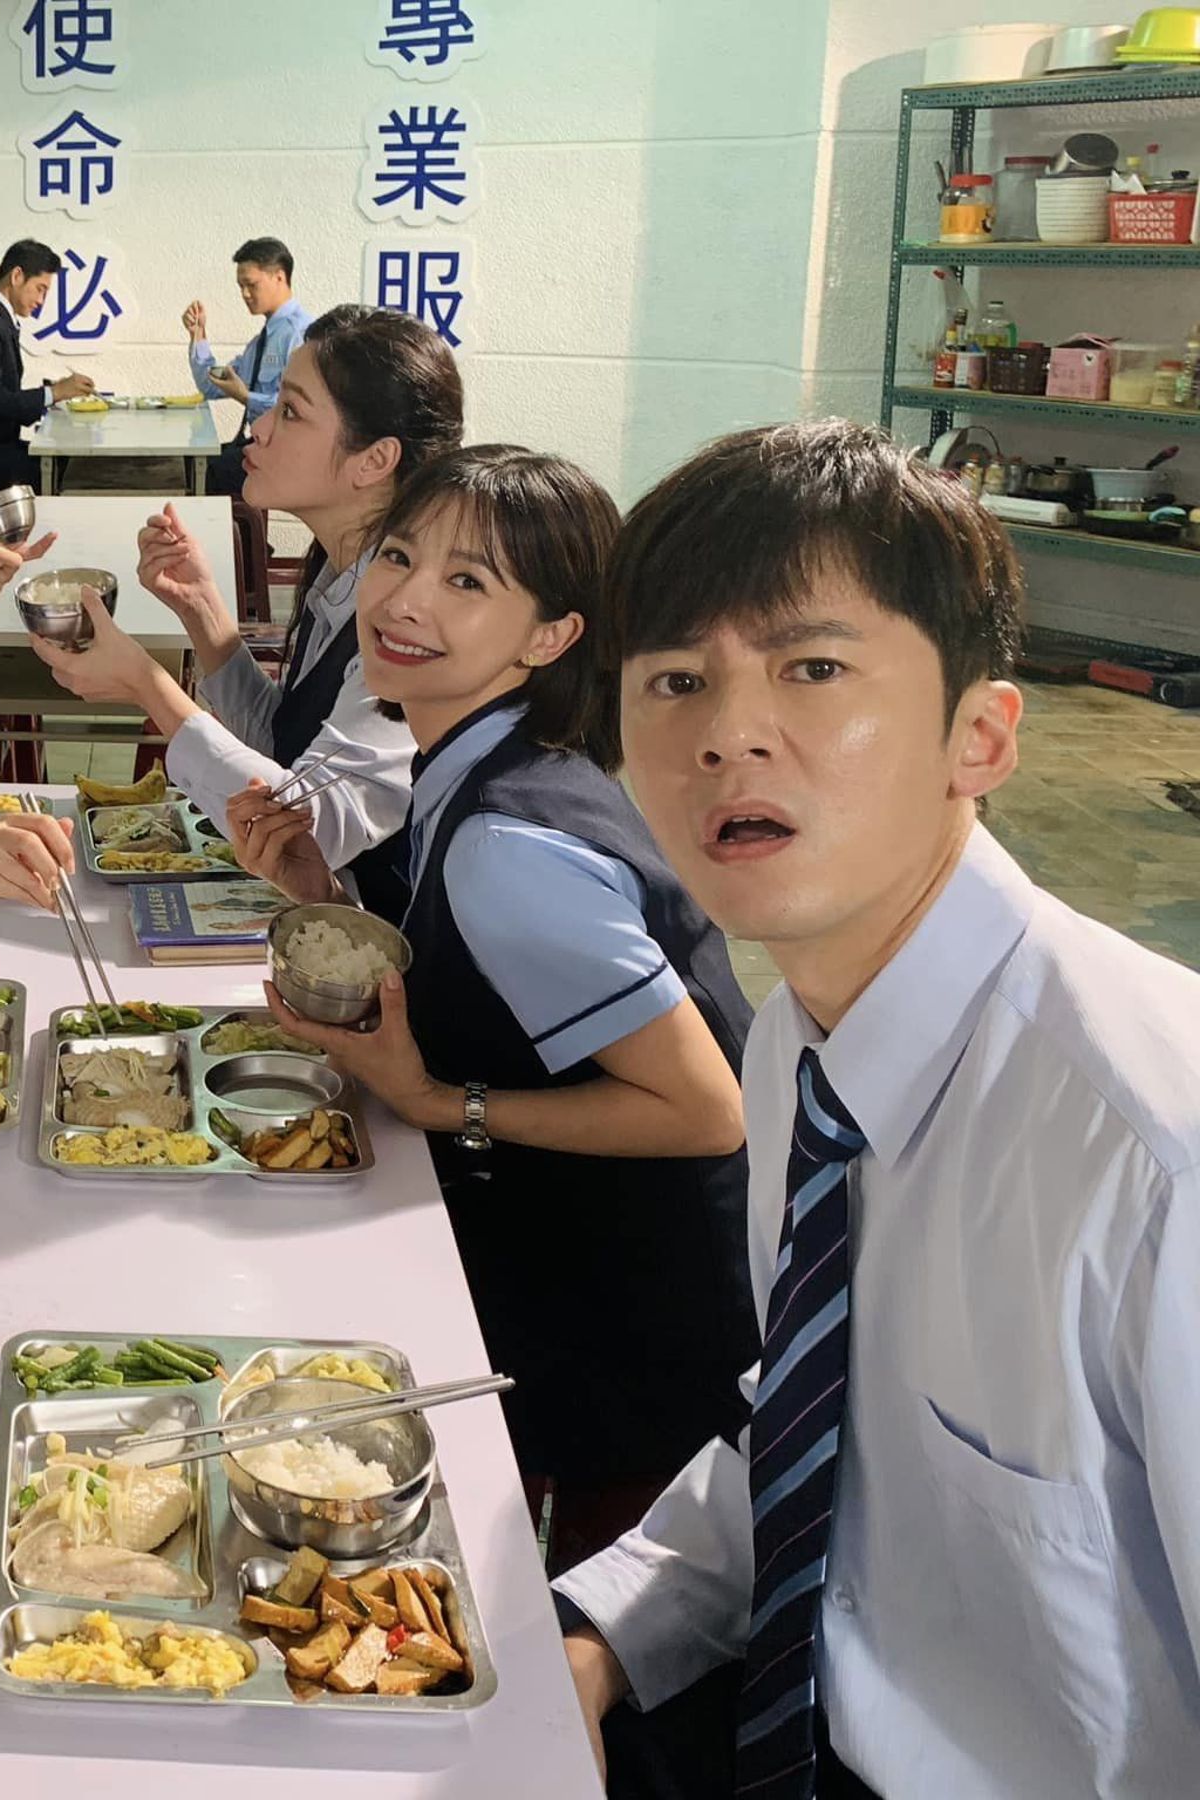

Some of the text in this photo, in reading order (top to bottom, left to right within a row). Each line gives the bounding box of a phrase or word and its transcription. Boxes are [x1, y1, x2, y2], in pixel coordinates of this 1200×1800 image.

[22, 0, 123, 432] 使命必
[372, 0, 474, 347] 專業服
